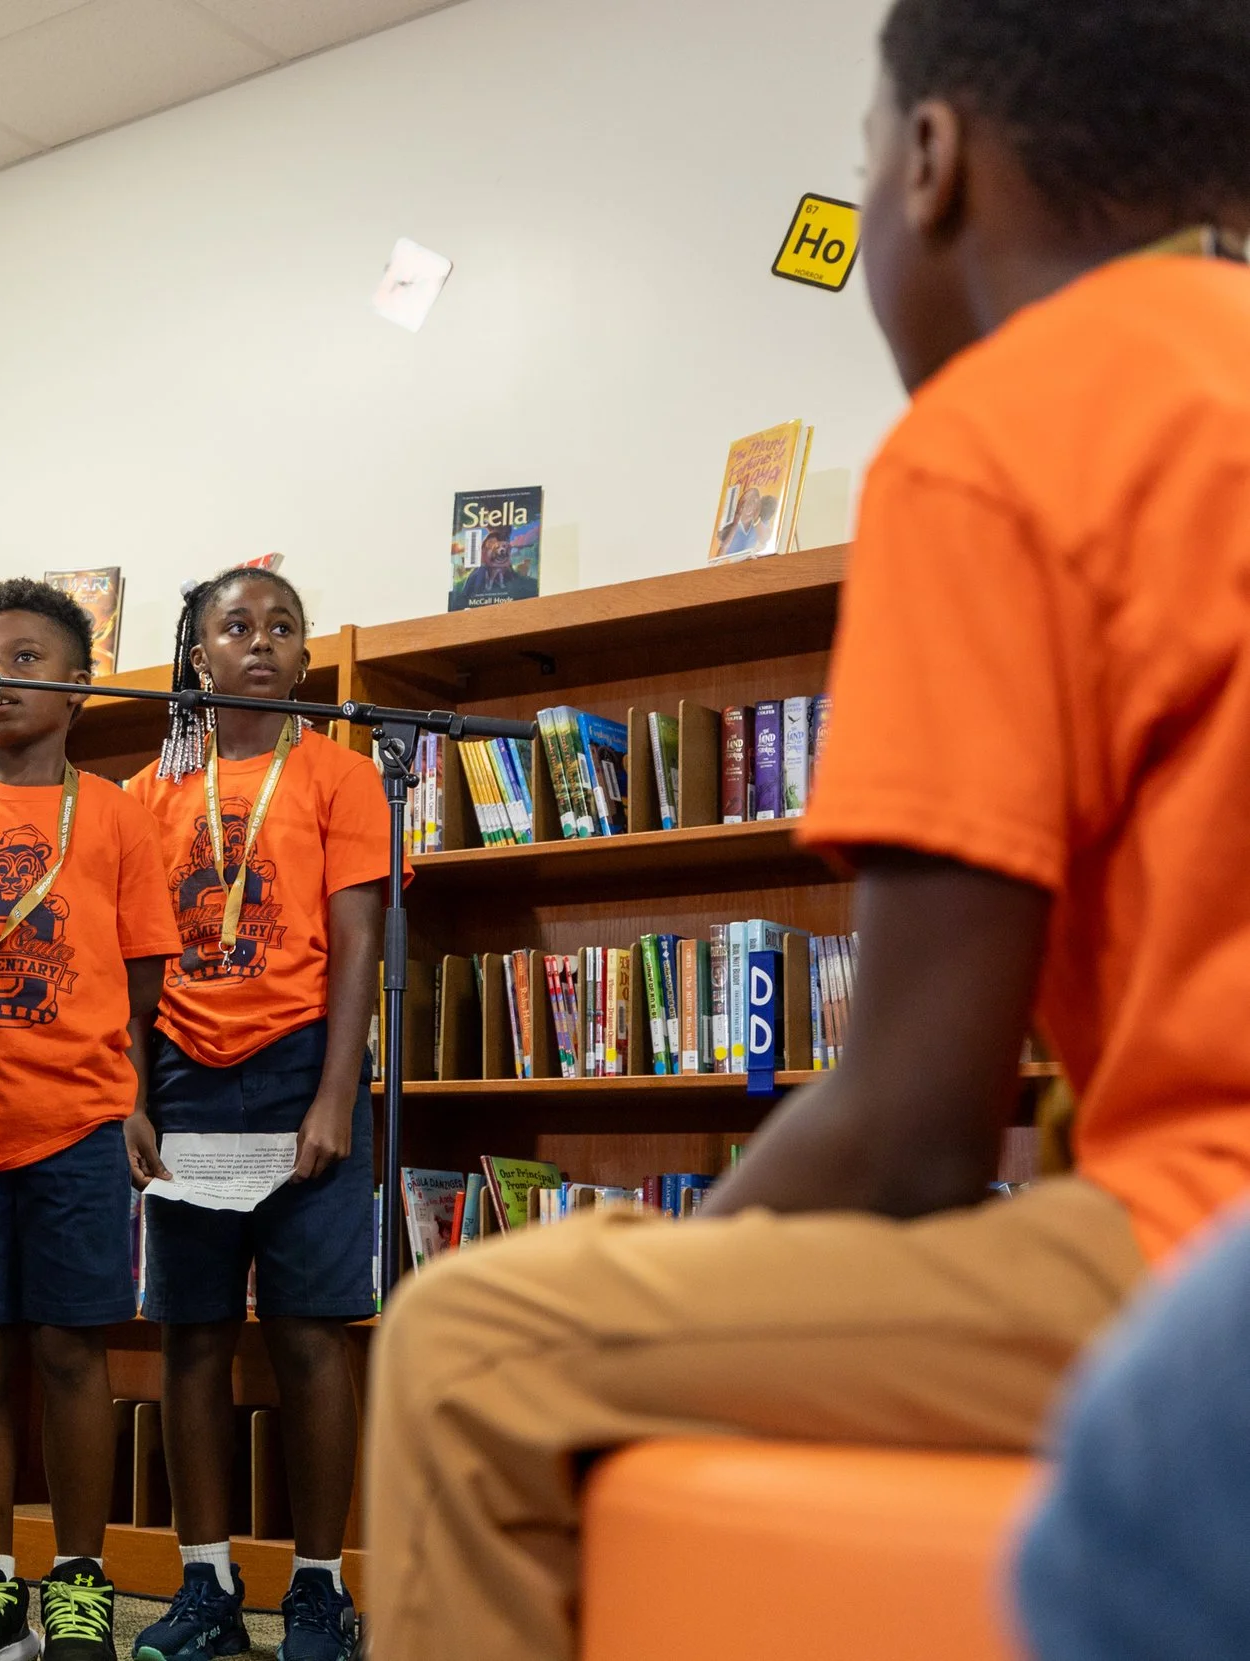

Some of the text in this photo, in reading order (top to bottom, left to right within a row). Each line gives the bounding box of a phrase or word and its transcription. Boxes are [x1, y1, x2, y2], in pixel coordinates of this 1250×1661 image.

[805, 204, 819, 215] 67
[793, 222, 845, 264] Ho
[794, 268, 824, 280] HORROR
[462, 501, 528, 528] Stella
[181, 924, 269, 942] LEMEARY
[750, 965, 773, 1006] D
[519, 987, 528, 1008] Ruby
[750, 1013, 772, 1054] D
[407, 1176, 464, 1191] PAULA DANZIGER
[499, 1167, 555, 1186] Our Principal
